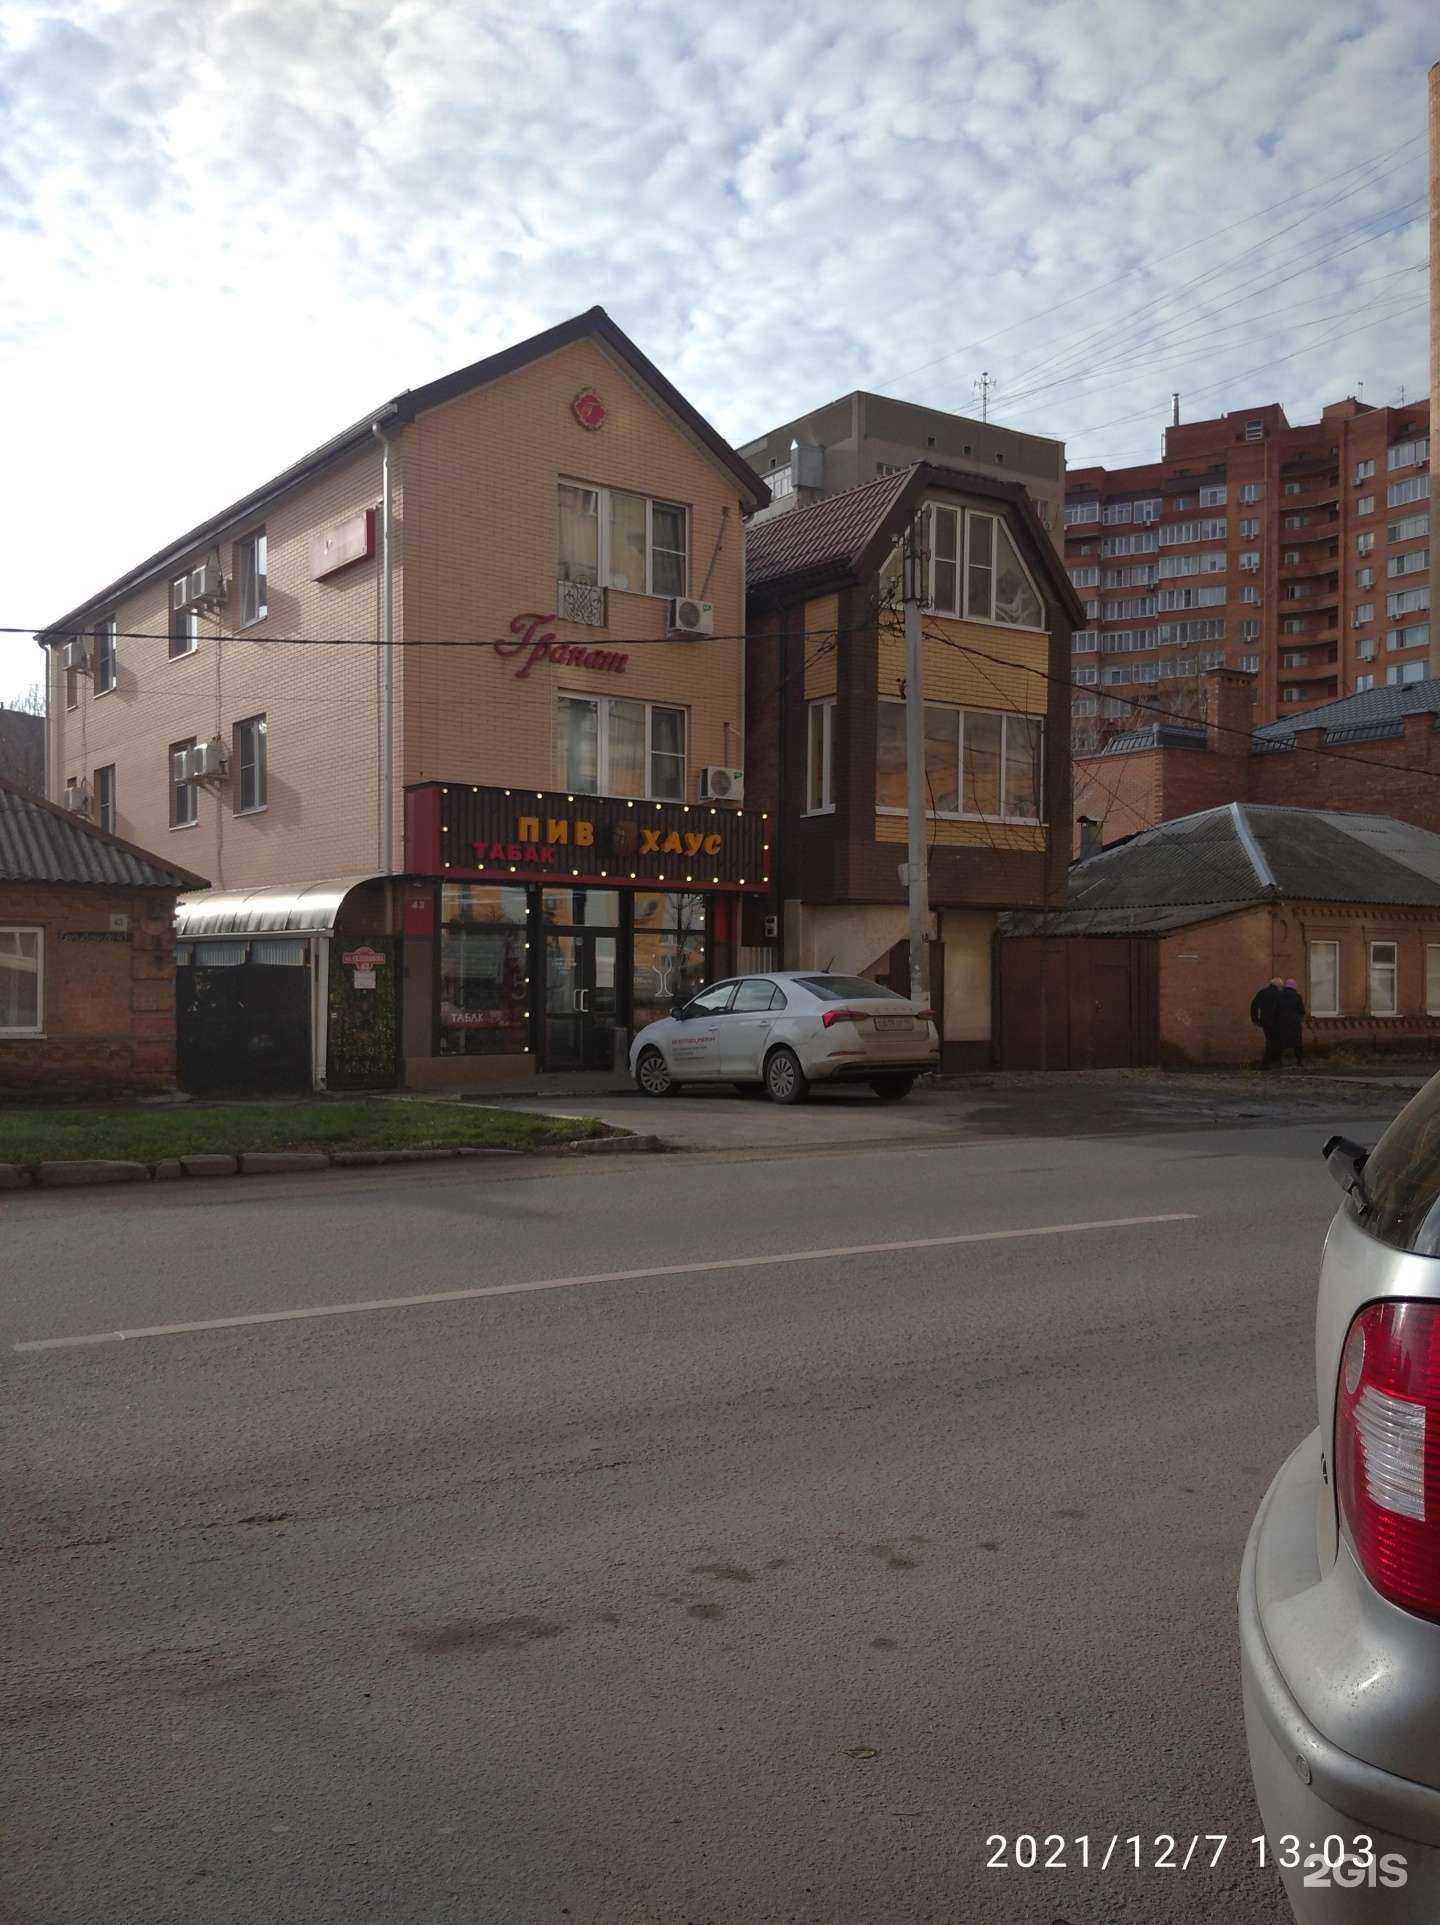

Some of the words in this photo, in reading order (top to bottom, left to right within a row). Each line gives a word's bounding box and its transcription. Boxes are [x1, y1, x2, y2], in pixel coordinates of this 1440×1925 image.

[517, 816, 595, 847] ПИВ
[640, 829, 722, 856] ХАУС
[472, 842, 555, 863] ТАБАК
[451, 1012, 484, 1025] ТАБАК
